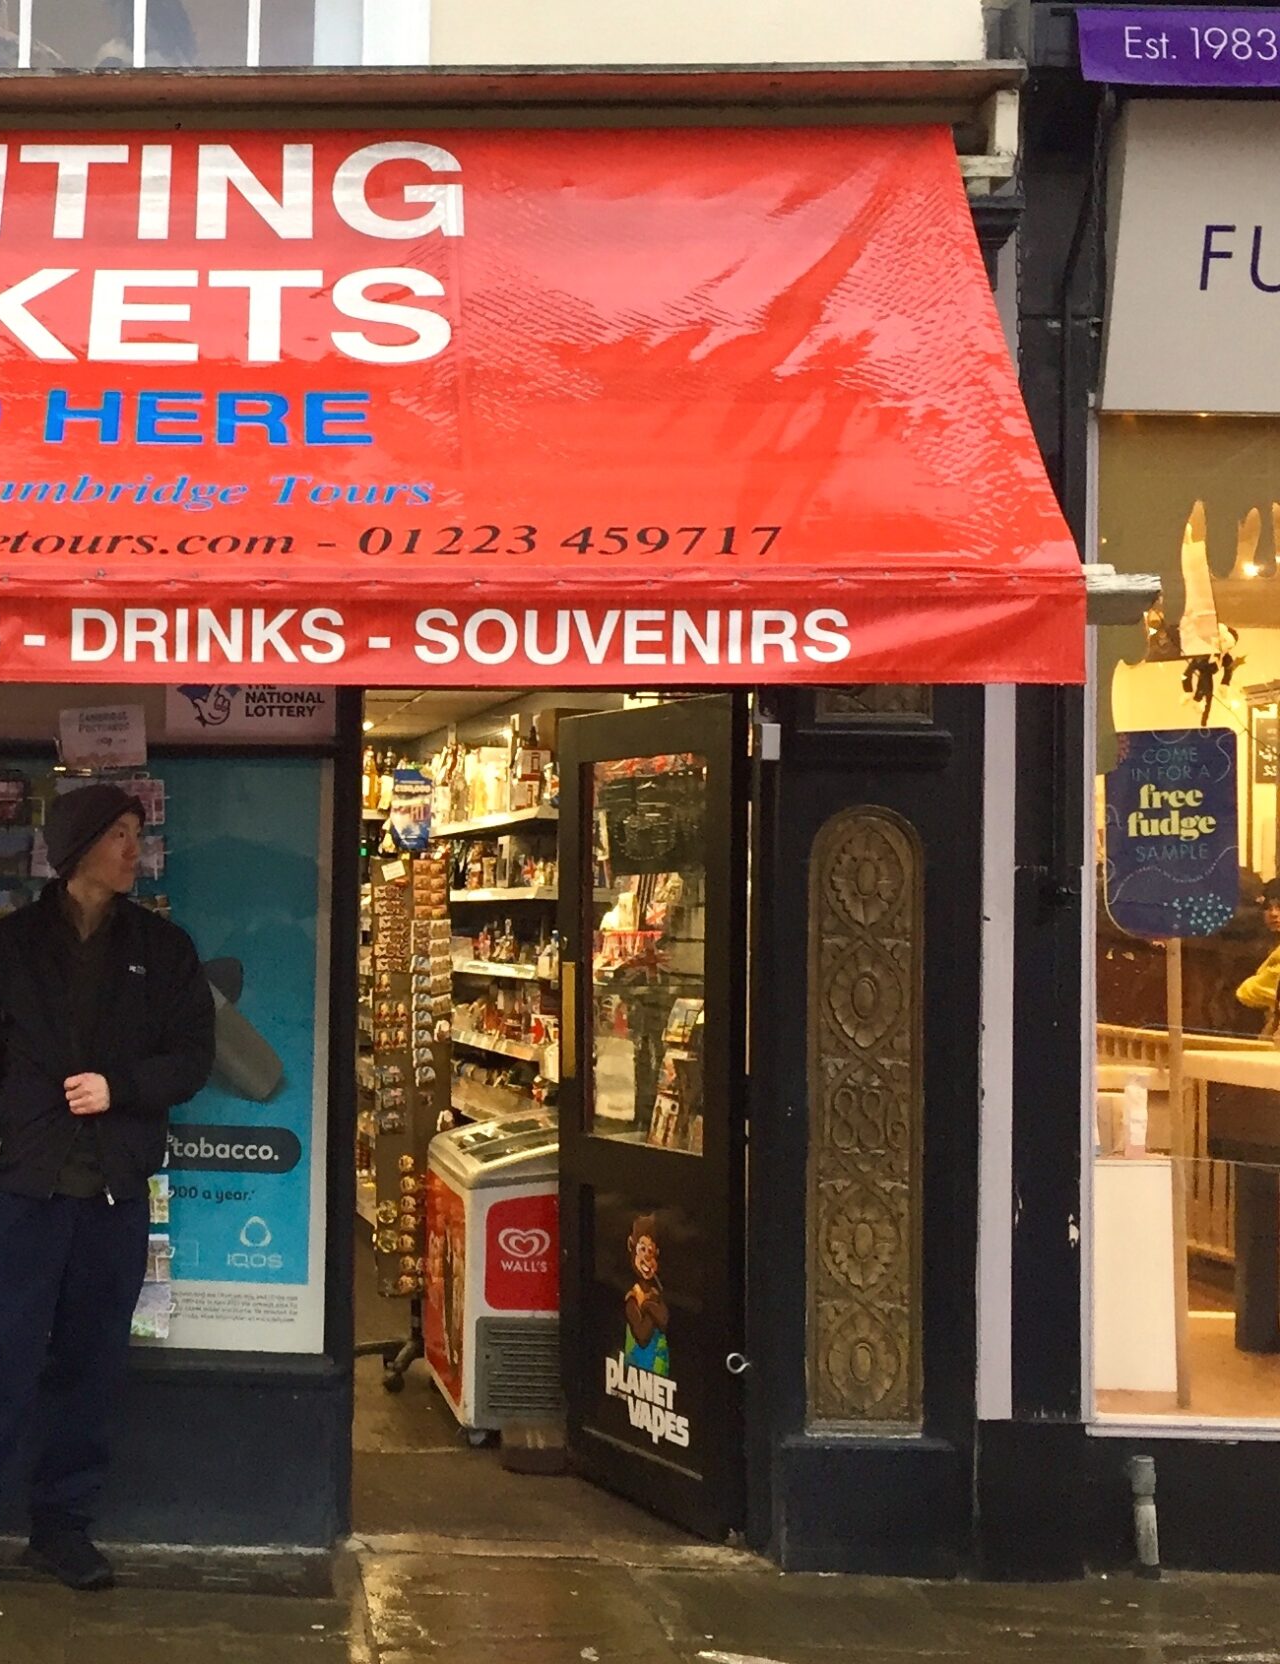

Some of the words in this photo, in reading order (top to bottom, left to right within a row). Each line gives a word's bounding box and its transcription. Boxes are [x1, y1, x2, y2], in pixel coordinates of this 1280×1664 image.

[1123, 26, 1177, 60] Est.
[1190, 26, 1277, 61] 1983
[43, 390, 375, 447] HERE
[268, 474, 435, 507] Tours
[358, 525, 538, 556] 01223
[560, 524, 783, 556] 459717
[70, 607, 346, 664] DRINKS
[414, 608, 851, 665] SOUVENIRS
[245, 691, 325, 704] NATIONAL
[245, 705, 316, 718] LOTTERY
[1142, 747, 1198, 764] COME
[1131, 767, 1149, 782] IN
[1157, 765, 1193, 781] FOR
[1199, 763, 1211, 778] A
[1139, 783, 1204, 809] free
[1127, 810, 1217, 841] fudge
[1135, 843, 1209, 862] SAMPLE
[172, 1136, 280, 1161] tobacco.
[202, 1189, 212, 1200] a
[227, 1253, 284, 1268] IQOS
[501, 1260, 548, 1273] WALL'S
[605, 1350, 677, 1411] PLANET
[627, 1394, 690, 1448] VAPES
